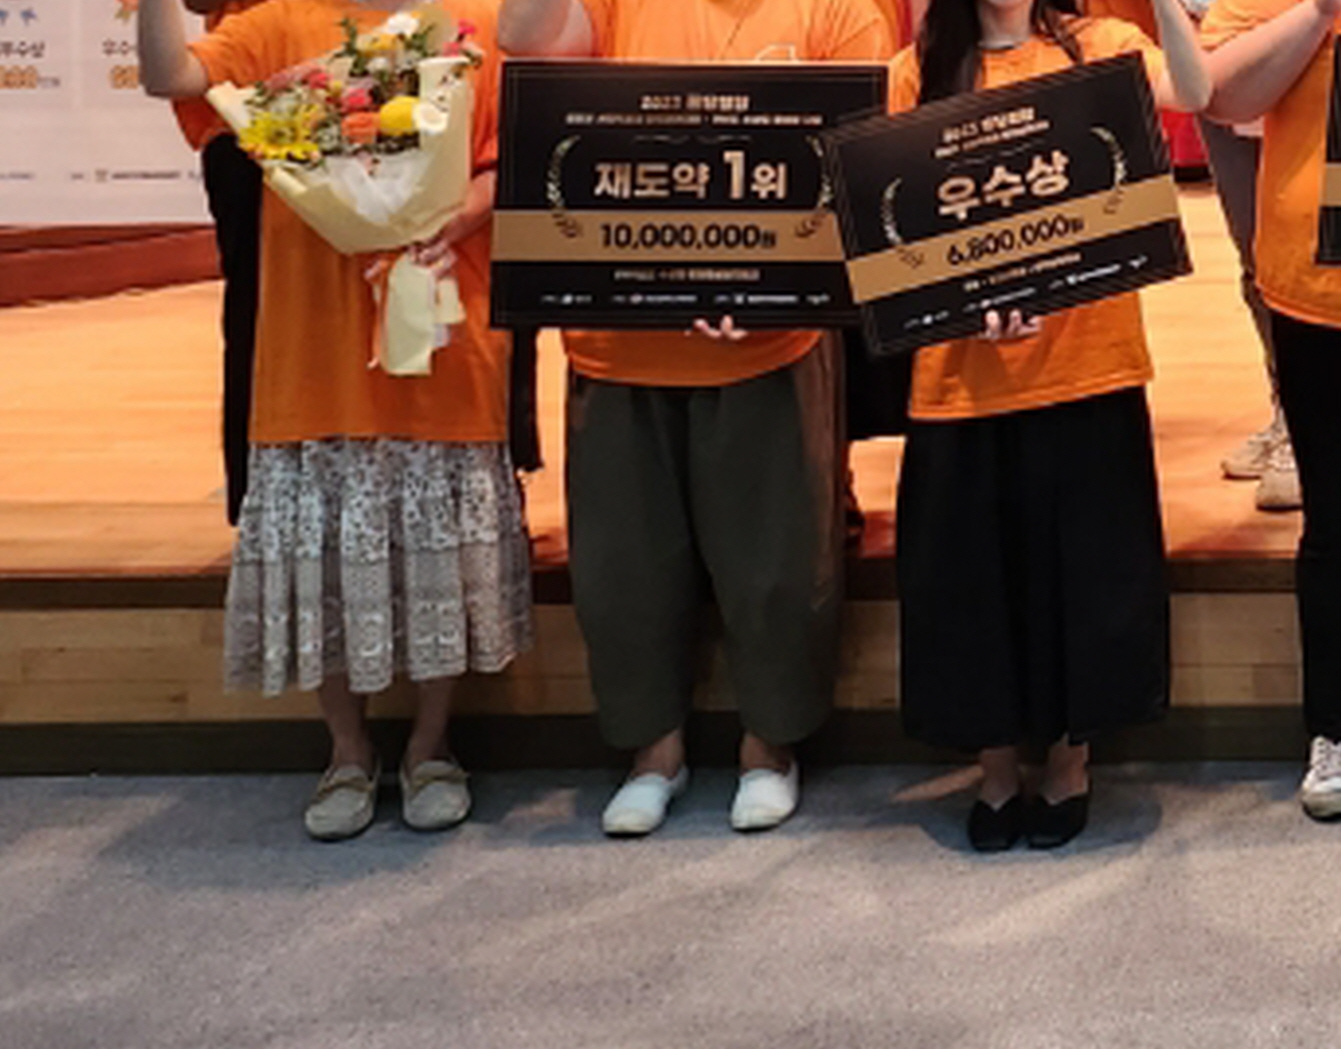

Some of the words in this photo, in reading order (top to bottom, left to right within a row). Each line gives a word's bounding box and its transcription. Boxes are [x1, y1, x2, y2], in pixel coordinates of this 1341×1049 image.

[594, 161, 711, 201] 재도약
[722, 150, 788, 201] 1위
[937, 149, 1070, 221] 우수상
[600, 222, 777, 252] 10,000,000원
